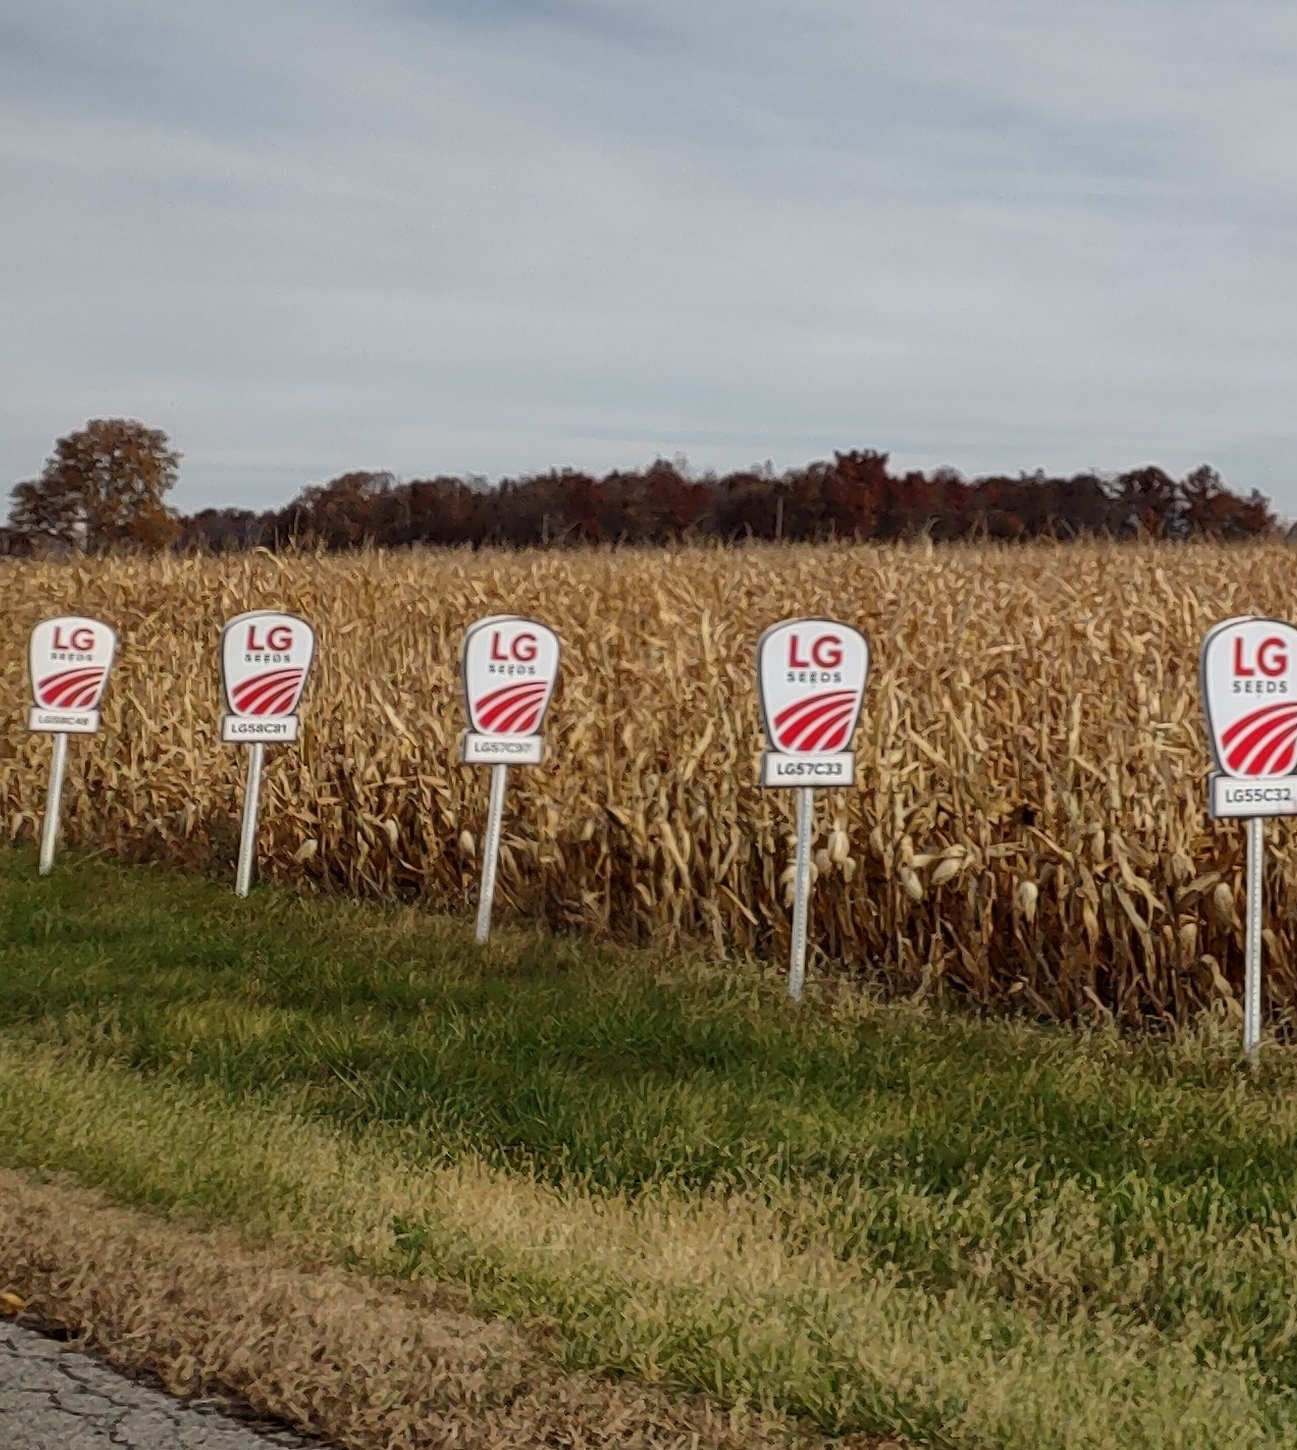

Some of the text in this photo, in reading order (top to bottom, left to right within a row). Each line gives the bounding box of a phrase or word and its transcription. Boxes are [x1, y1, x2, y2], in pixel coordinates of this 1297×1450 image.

[52, 626, 95, 650] LG
[247, 625, 293, 651] LG
[491, 631, 537, 661] LG
[788, 634, 843, 669] LG
[1233, 636, 1288, 677] LG
[787, 671, 842, 683] SEEDS
[1232, 680, 1288, 694] SEEDS
[777, 762, 843, 775] LG57C33
[1225, 787, 1291, 803] LG55C32
